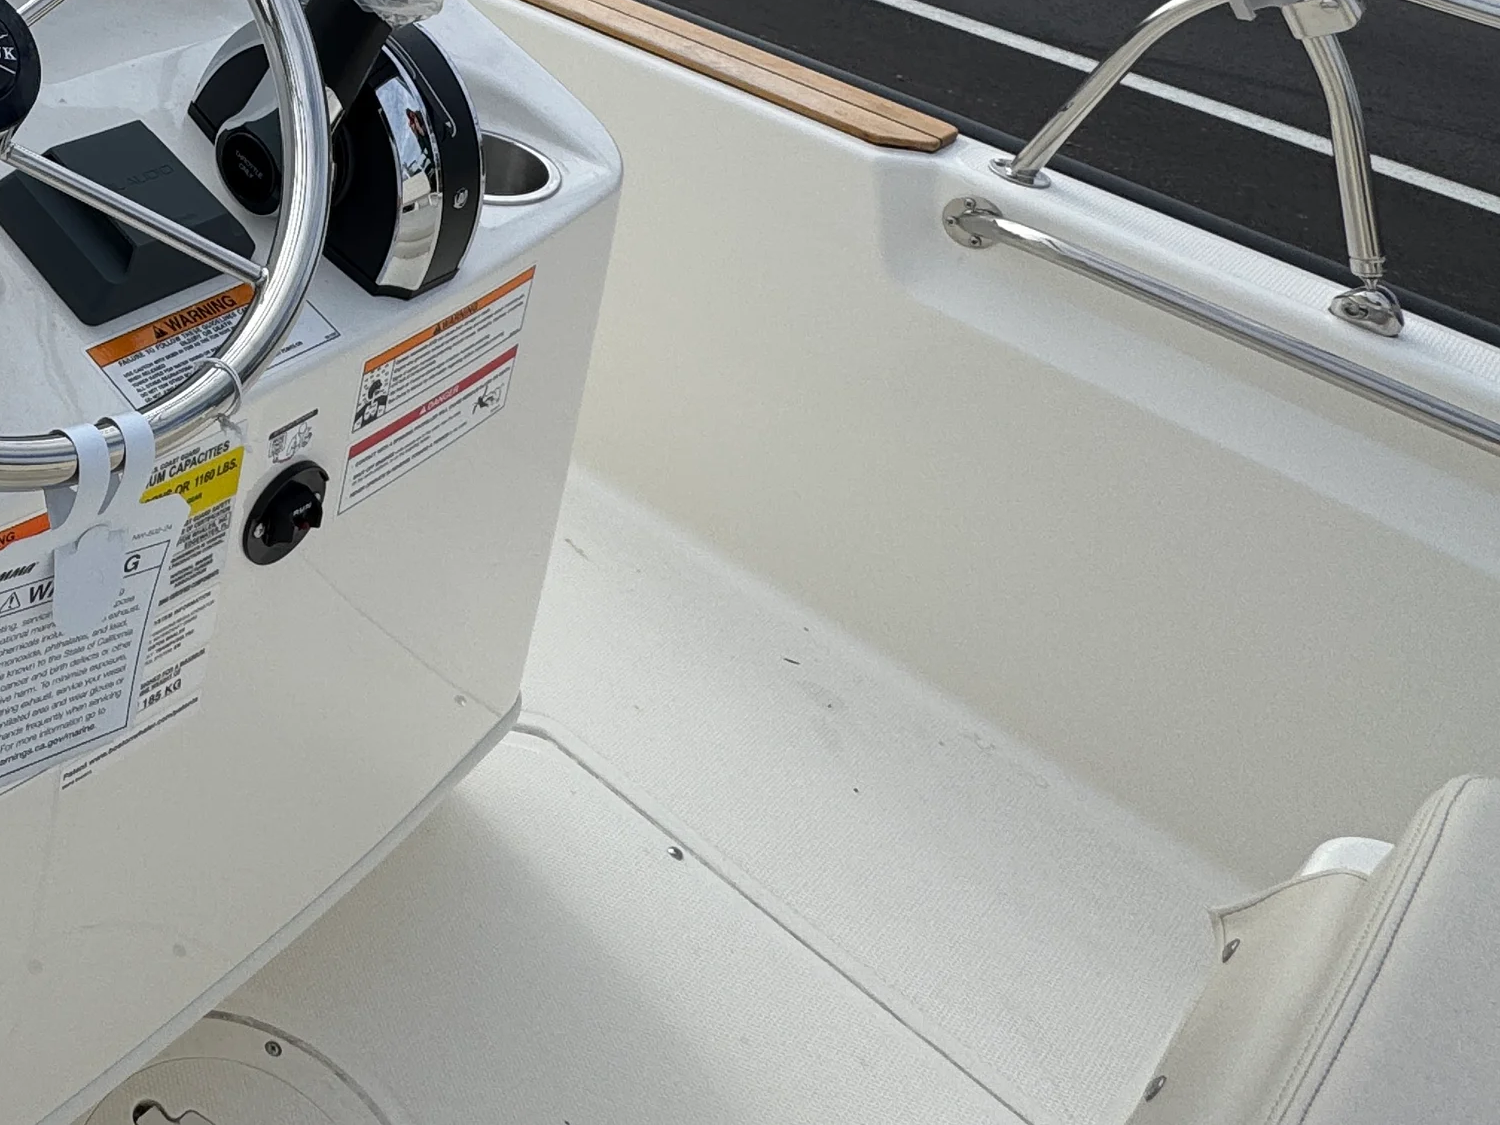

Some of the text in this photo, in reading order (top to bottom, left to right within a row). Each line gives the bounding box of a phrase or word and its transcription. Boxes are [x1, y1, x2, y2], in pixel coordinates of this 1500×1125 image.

[127, 164, 174, 186] AUDIO
[165, 295, 237, 332] WARNING
[118, 352, 144, 366] FAILURE
[155, 336, 180, 349] FOLLOW
[169, 440, 230, 478] CAPACITIES
[175, 480, 190, 494] OR
[216, 458, 237, 476] LBS.
[22, 610, 52, 625] servicin
[30, 621, 56, 633] marin
[6, 663, 35, 677] known
[37, 659, 46, 667] to
[48, 654, 61, 663] the
[63, 646, 85, 657] State
[86, 640, 95, 650] of
[97, 629, 133, 645] California
[44, 634, 88, 654] phthalates,
[91, 625, 108, 636] and
[0, 677, 28, 691] cancer
[30, 669, 47, 680] and
[49, 662, 67, 675] birth
[69, 652, 99, 667] defects
[111, 640, 131, 652] other
[13, 686, 36, 698] harm.
[40, 680, 50, 688] To
[52, 667, 87, 684] minimize
[89, 654, 126, 671] exposure,
[20, 691, 52, 708] exhaust,
[56, 681, 83, 695] service
[84, 674, 100, 686] your
[103, 664, 126, 677] vessel
[31, 705, 49, 716] area
[51, 698, 67, 709] and
[68, 691, 87, 702] wear
[89, 681, 114, 696] gloves
[115, 677, 124, 685] or
[143, 678, 182, 709] 185 KG
[25, 712, 63, 730] frequently
[65, 702, 86, 715] when
[88, 689, 121, 706] servicing
[0, 742, 14, 753] For
[15, 734, 37, 747] more
[39, 716, 83, 737] information
[85, 711, 95, 721] go
[97, 707, 106, 715] to
